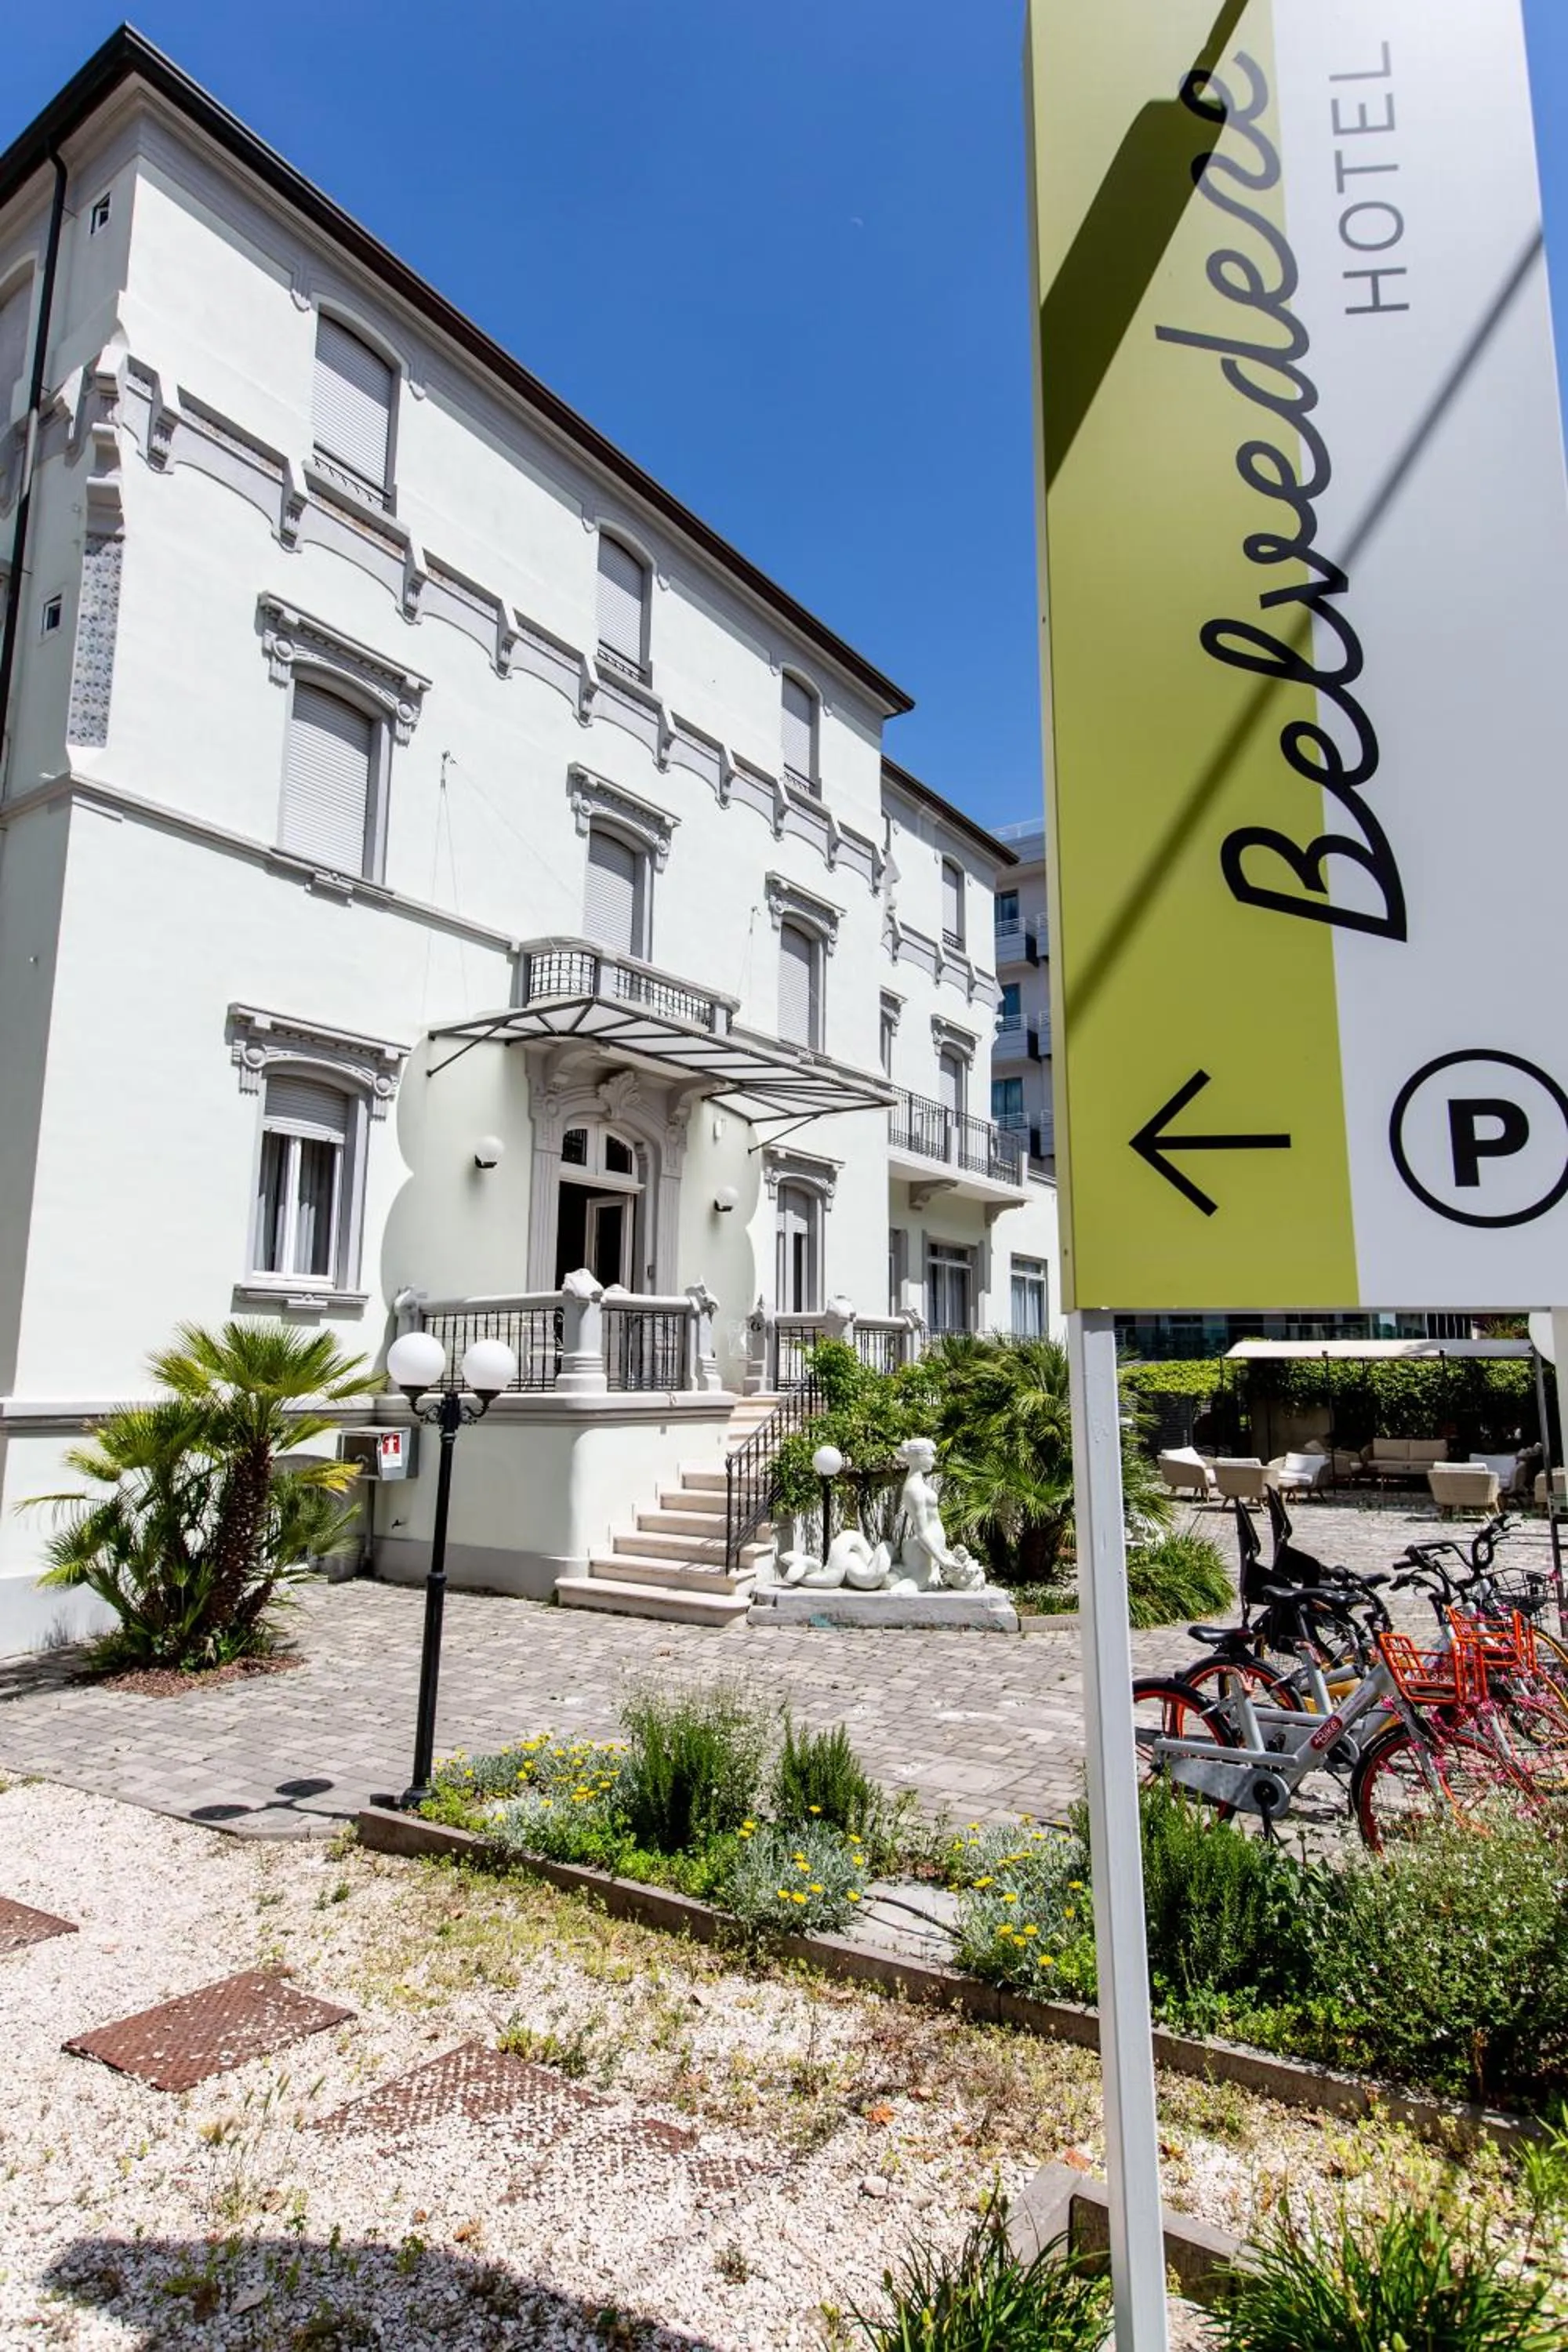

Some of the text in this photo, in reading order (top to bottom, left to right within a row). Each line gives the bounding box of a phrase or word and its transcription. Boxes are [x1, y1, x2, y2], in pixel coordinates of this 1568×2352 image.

[1329, 41, 1409, 314] HOTEL
[1155, 51, 1406, 942] Belvedere
[1447, 1098, 1530, 1187] P
